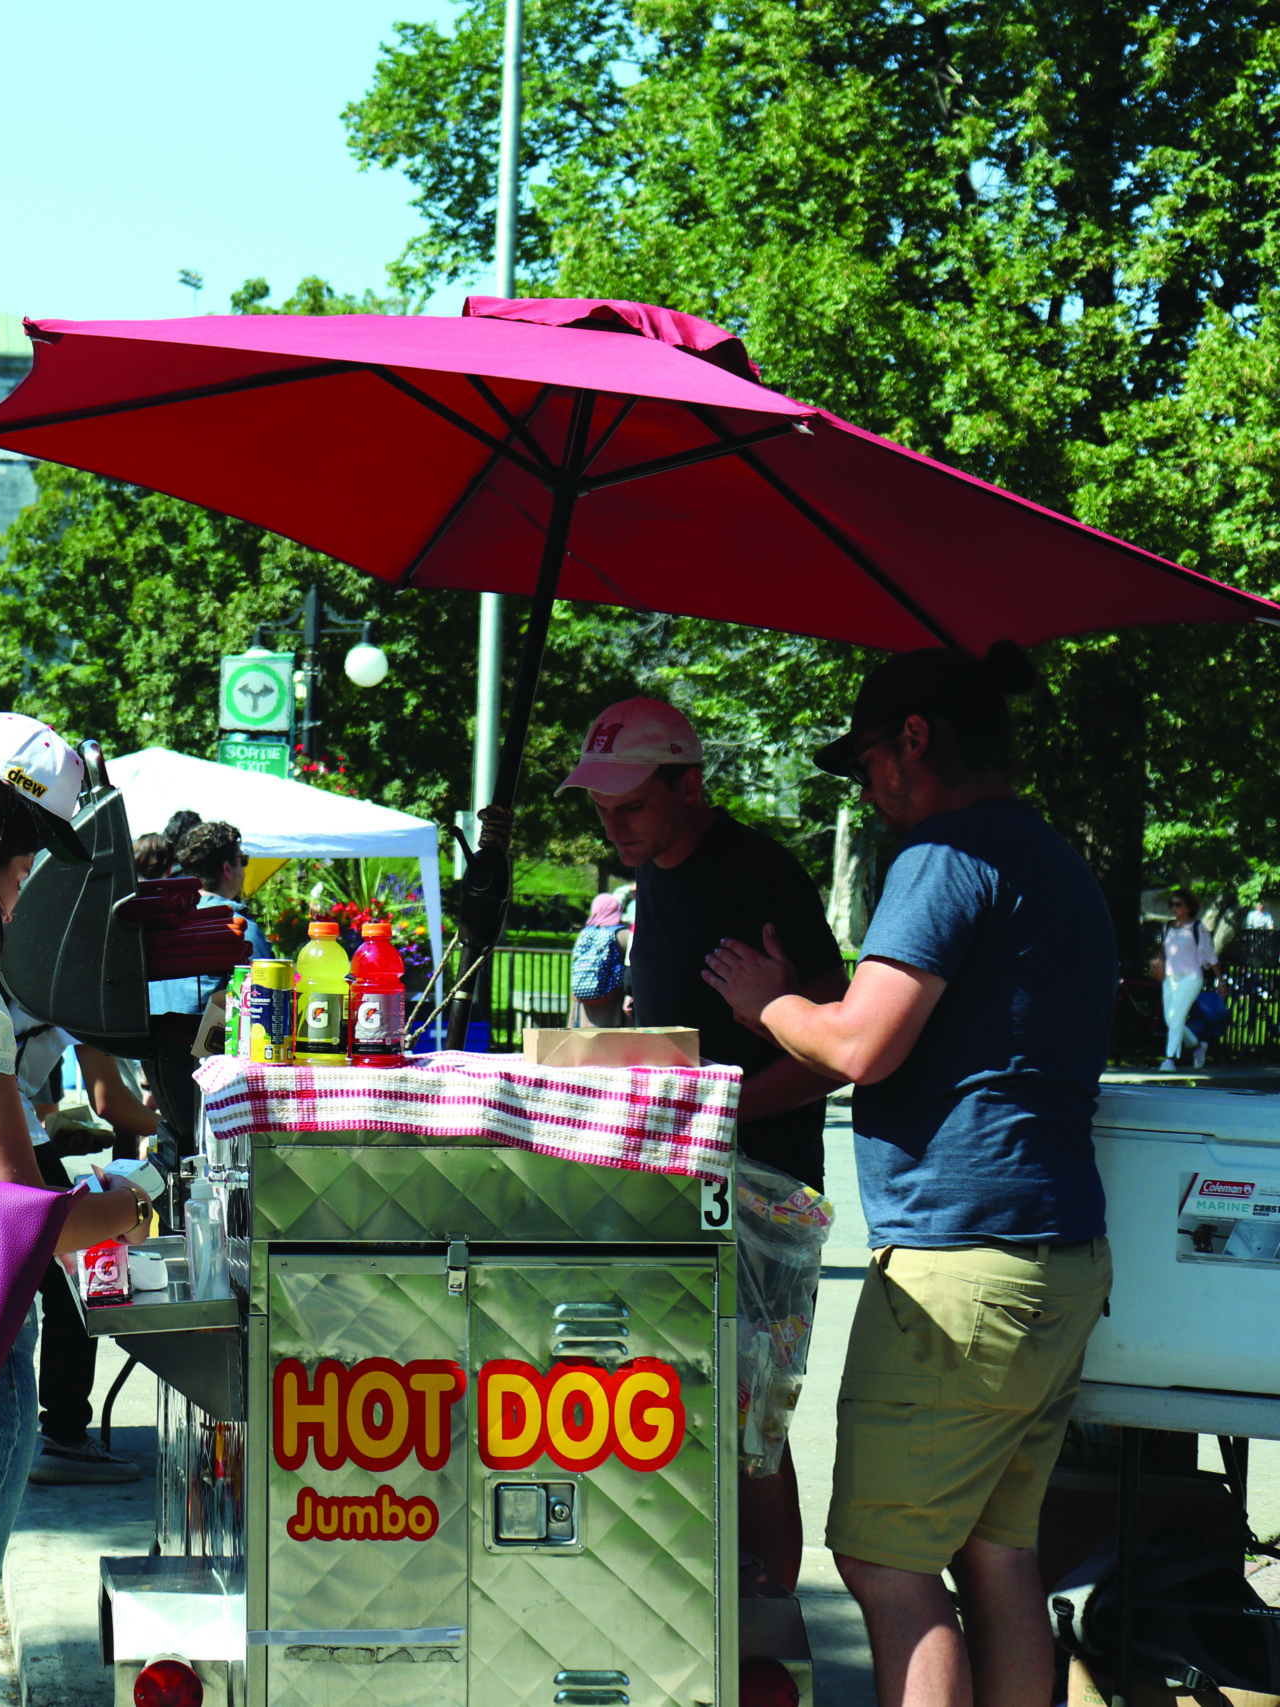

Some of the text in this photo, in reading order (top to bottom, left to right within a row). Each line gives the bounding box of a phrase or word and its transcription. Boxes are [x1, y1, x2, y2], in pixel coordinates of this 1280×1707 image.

[225, 744, 281, 760] SORTIE
[236, 760, 270, 773] EXIT
[7, 767, 46, 798] drew
[306, 1001, 328, 1029] G
[358, 1001, 380, 1029] G
[704, 1176, 729, 1227] 3
[1203, 1181, 1243, 1194] Coleman
[1197, 1200, 1250, 1212] MARINE
[279, 1365, 679, 1465] HOT DOG
[291, 1490, 435, 1538] Jumbo
